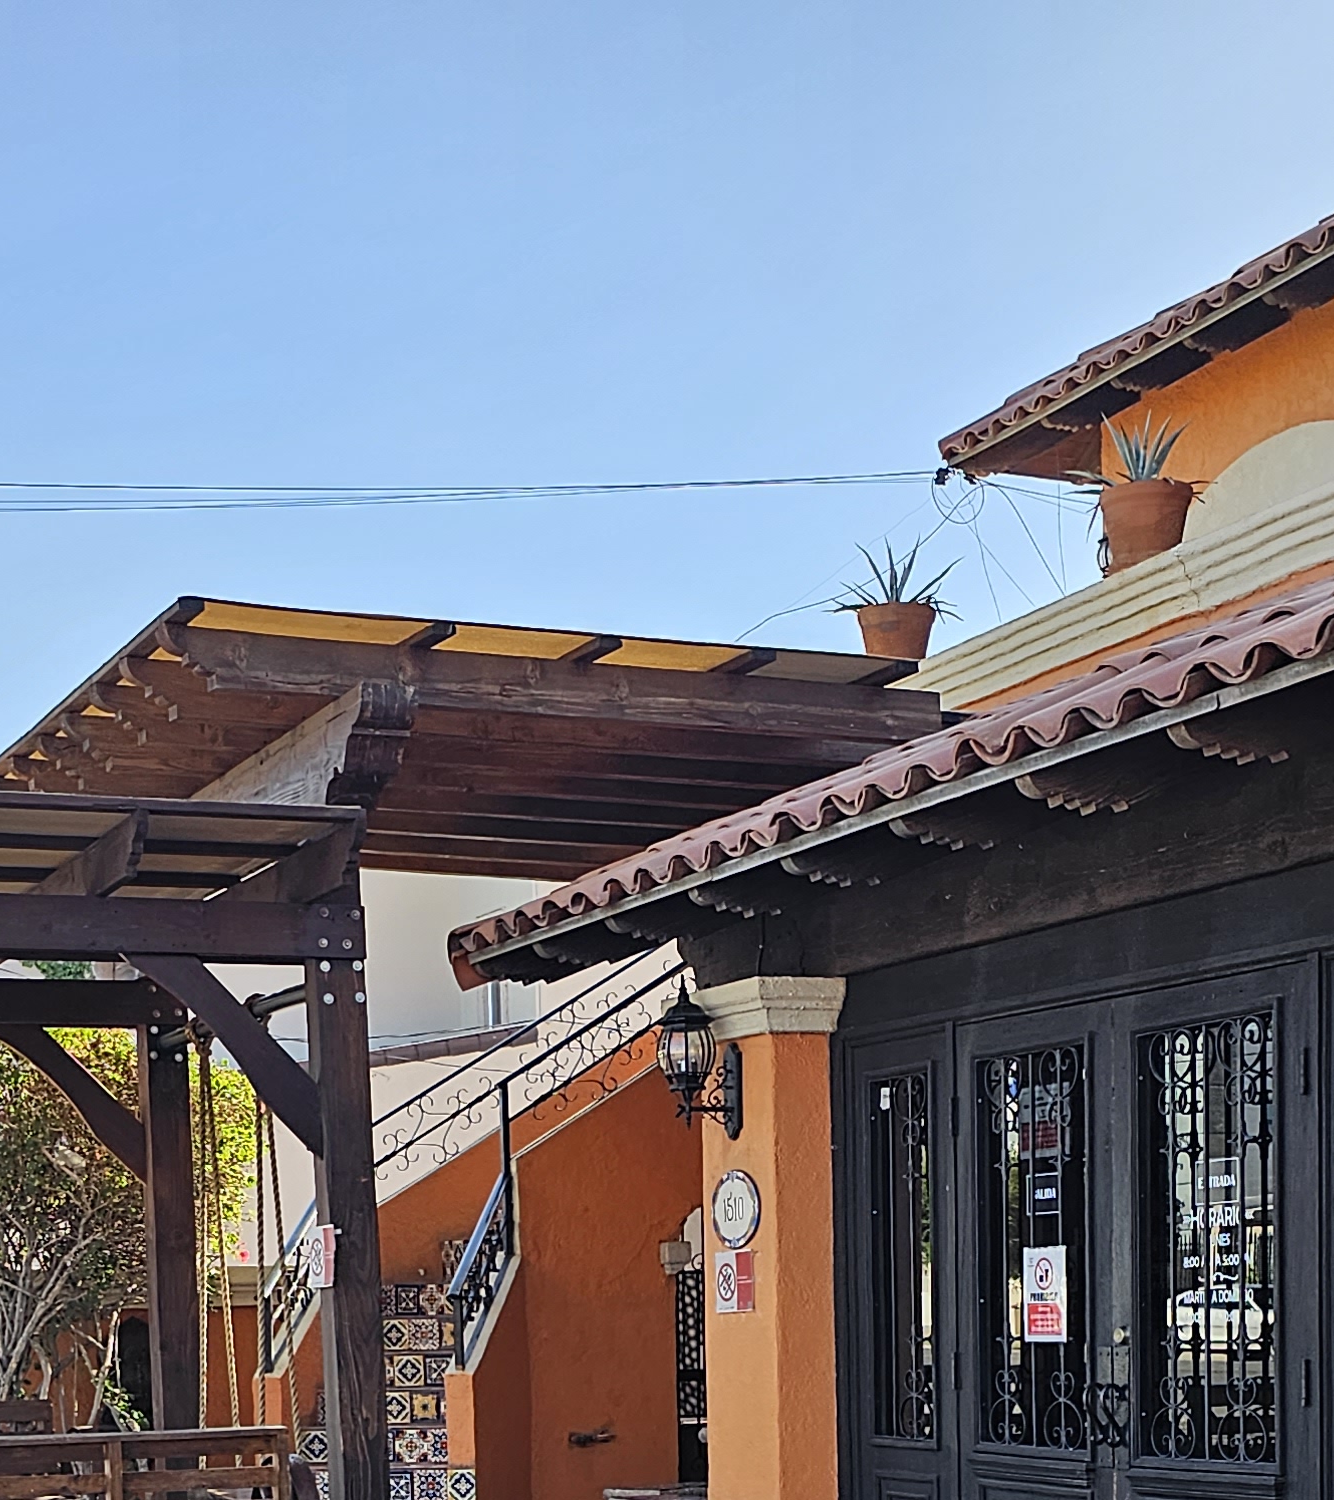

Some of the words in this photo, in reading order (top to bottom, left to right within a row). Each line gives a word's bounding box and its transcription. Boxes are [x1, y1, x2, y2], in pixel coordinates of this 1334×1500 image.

[1198, 1174, 1236, 1190] ETRADA
[1034, 1187, 1056, 1200] ALIDA
[723, 1191, 744, 1222] 1510
[1182, 1255, 1200, 1269] 8:00
[1183, 1290, 1205, 1305] MART
[1218, 1288, 1254, 1304] DOMO
